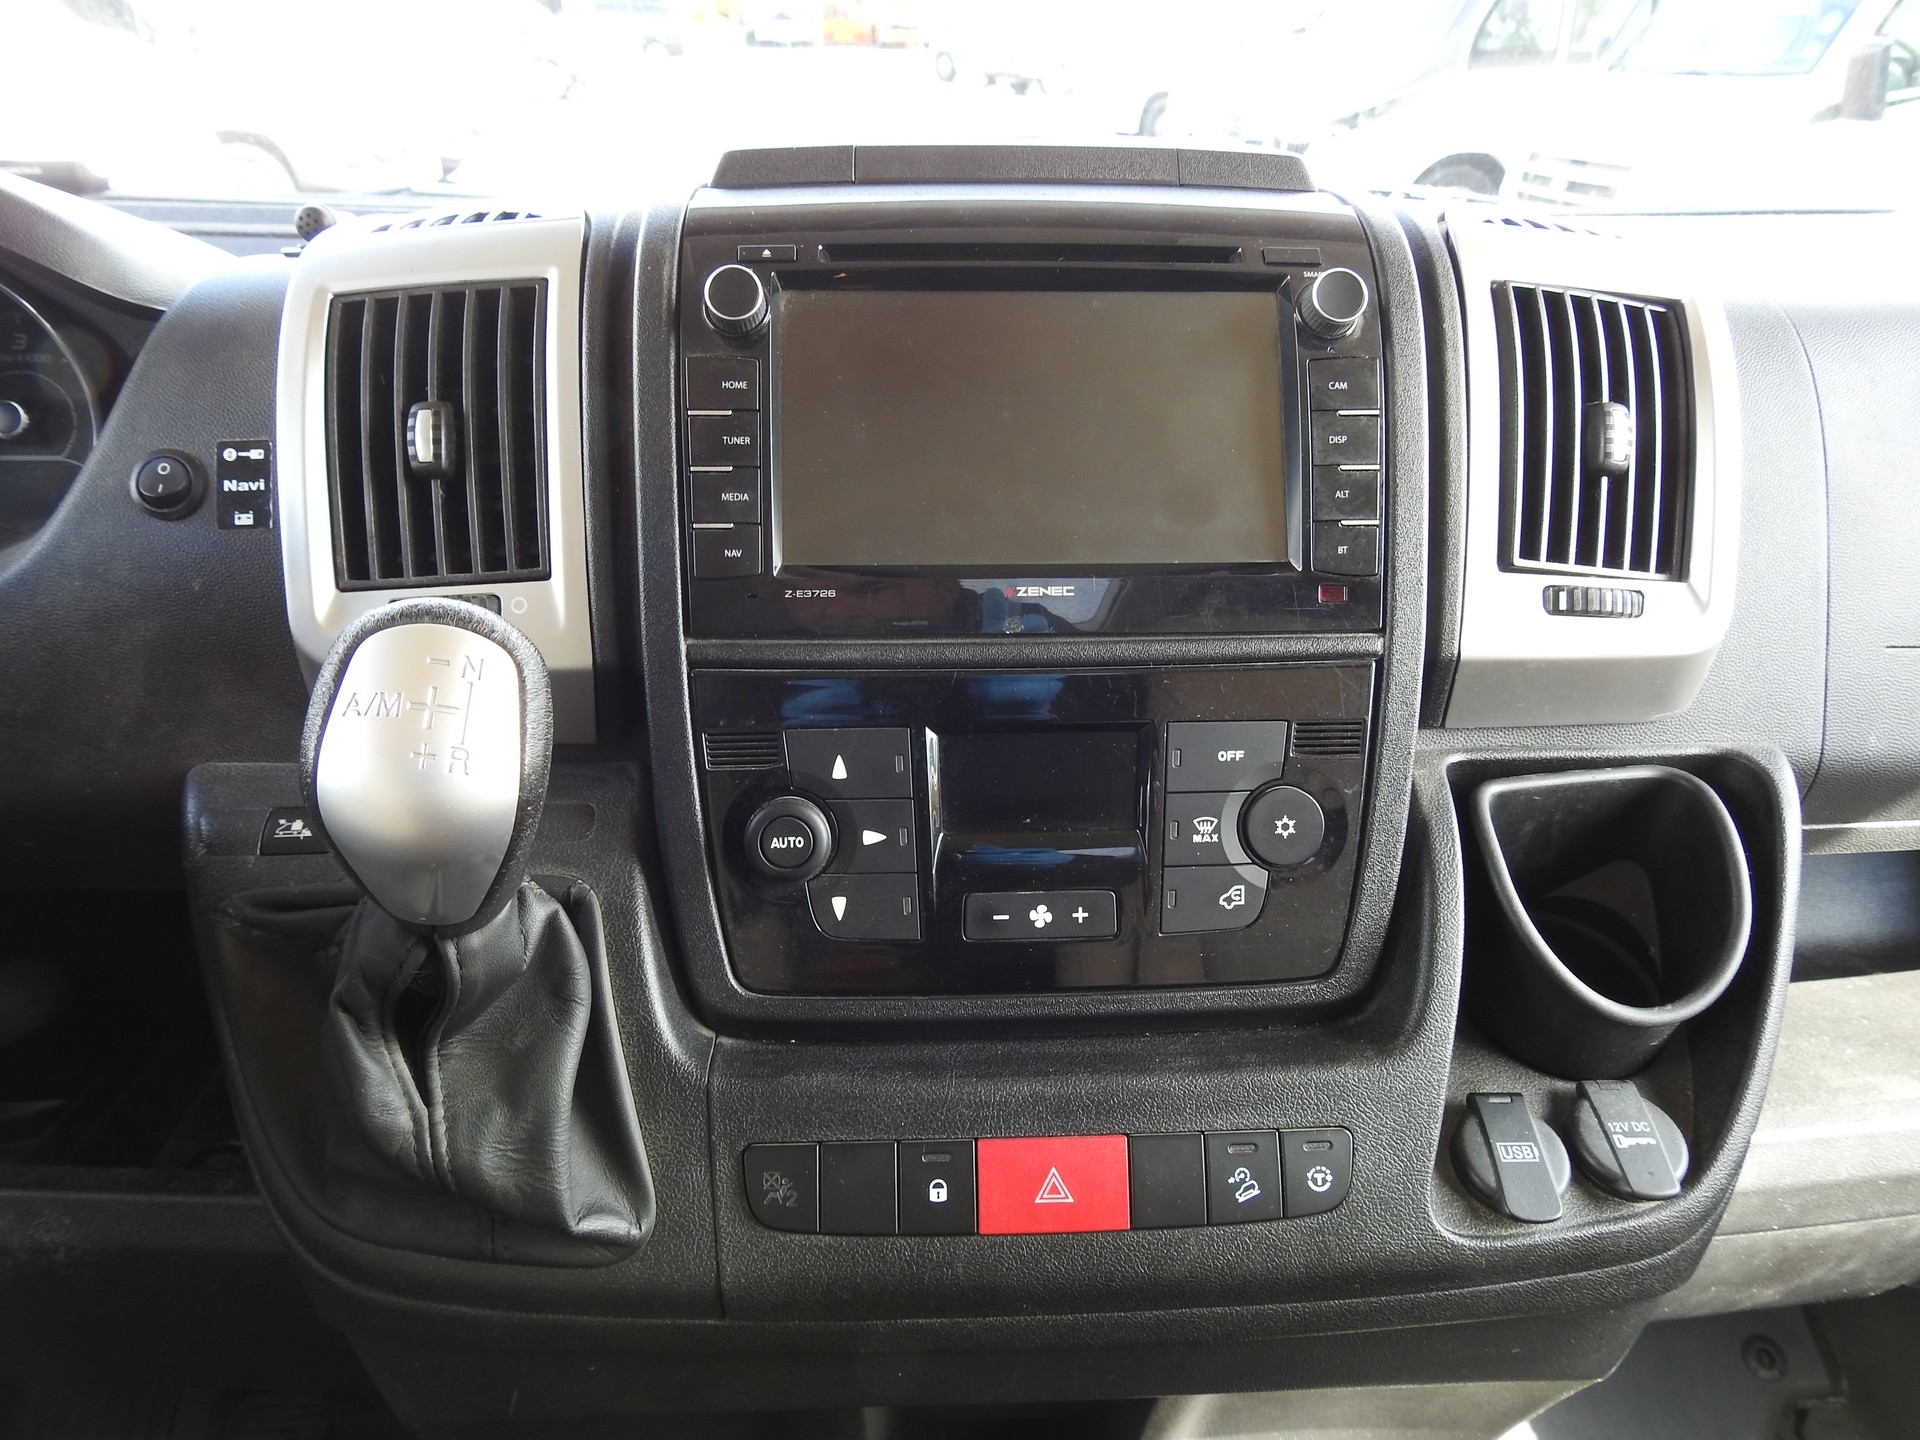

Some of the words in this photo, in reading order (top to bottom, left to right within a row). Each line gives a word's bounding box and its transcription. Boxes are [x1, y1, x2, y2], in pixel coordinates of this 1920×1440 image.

[722, 381, 748, 389] HOME
[1328, 381, 1348, 390] CAM
[722, 436, 751, 445] TUNER
[1329, 435, 1348, 444] DISP
[223, 479, 265, 492] Navi
[721, 492, 750, 502] MEDIA
[1335, 490, 1350, 499] ALT
[724, 549, 742, 558] NAV
[1337, 545, 1348, 555] BT
[784, 589, 837, 598] Z-E3726
[1016, 586, 1075, 597] ZENEC
[461, 655, 484, 681] N
[342, 692, 403, 718] A/M
[448, 745, 470, 776] R
[1217, 750, 1245, 762] OFF
[770, 835, 805, 849] AUTO
[1192, 834, 1219, 843] MAX
[1607, 1122, 1629, 1133] 12V
[1633, 1121, 1651, 1132] DC
[1502, 1145, 1534, 1160] USB
